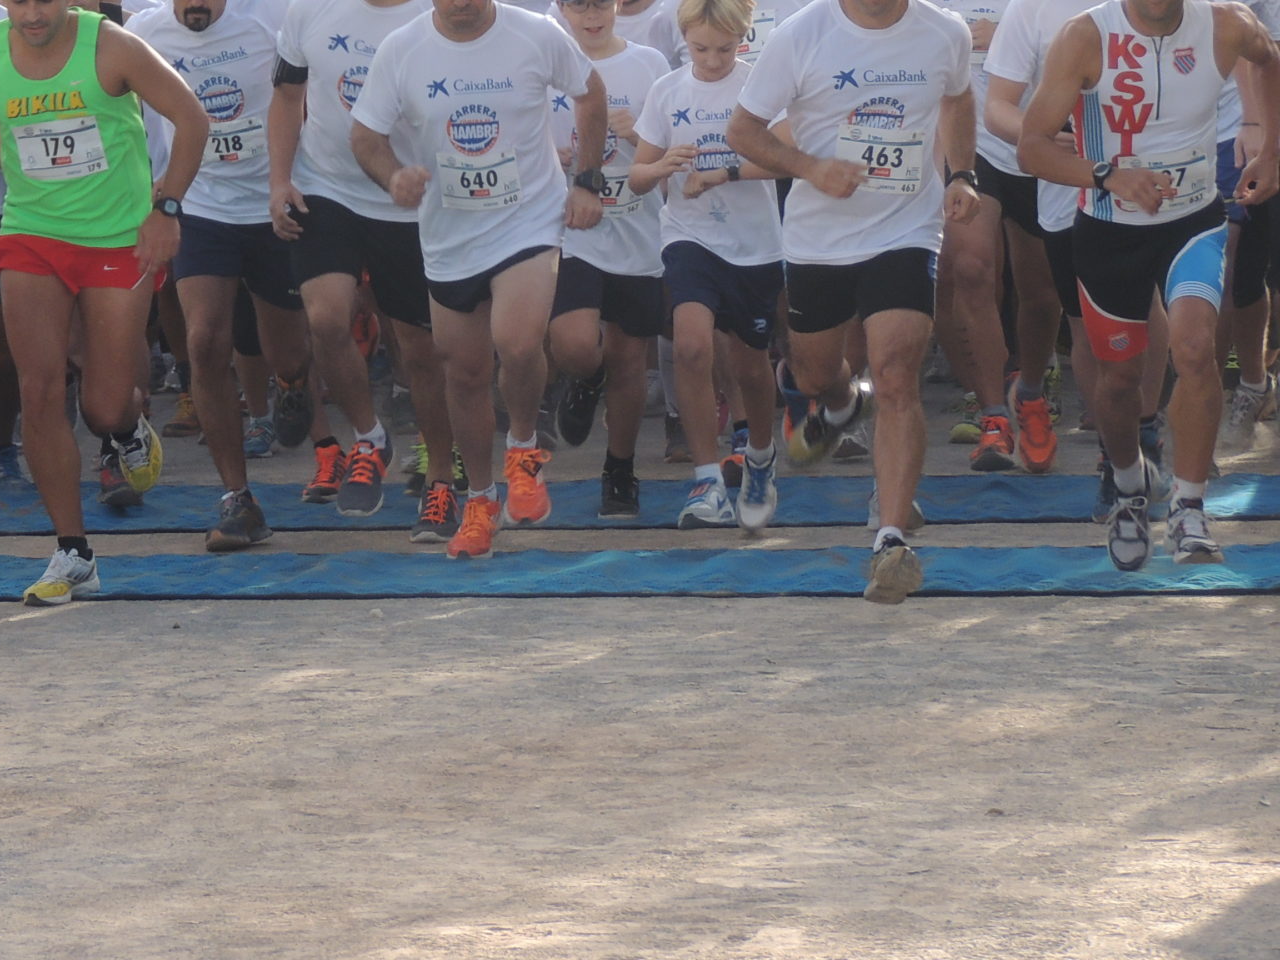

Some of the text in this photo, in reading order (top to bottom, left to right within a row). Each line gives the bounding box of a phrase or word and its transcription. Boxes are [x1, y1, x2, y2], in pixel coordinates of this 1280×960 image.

[191, 46, 248, 68] CaixaBank
[343, 66, 369, 80] CARR
[863, 69, 927, 83] CaixaBank
[194, 76, 238, 97] CARRERA
[453, 76, 514, 92] CaixaBank
[7, 90, 87, 119] BIKILA
[450, 103, 497, 123] CARRERA
[855, 96, 905, 115] CARRERA
[695, 108, 733, 121] CaixaB
[451, 123, 498, 140] HAMBRE
[41, 135, 76, 157] 179
[211, 135, 243, 153] 218
[861, 145, 904, 168] 463
[460, 170, 498, 188] 640
[901, 184, 916, 192] 463
[601, 180, 625, 197] 67
[503, 194, 518, 205] 640
